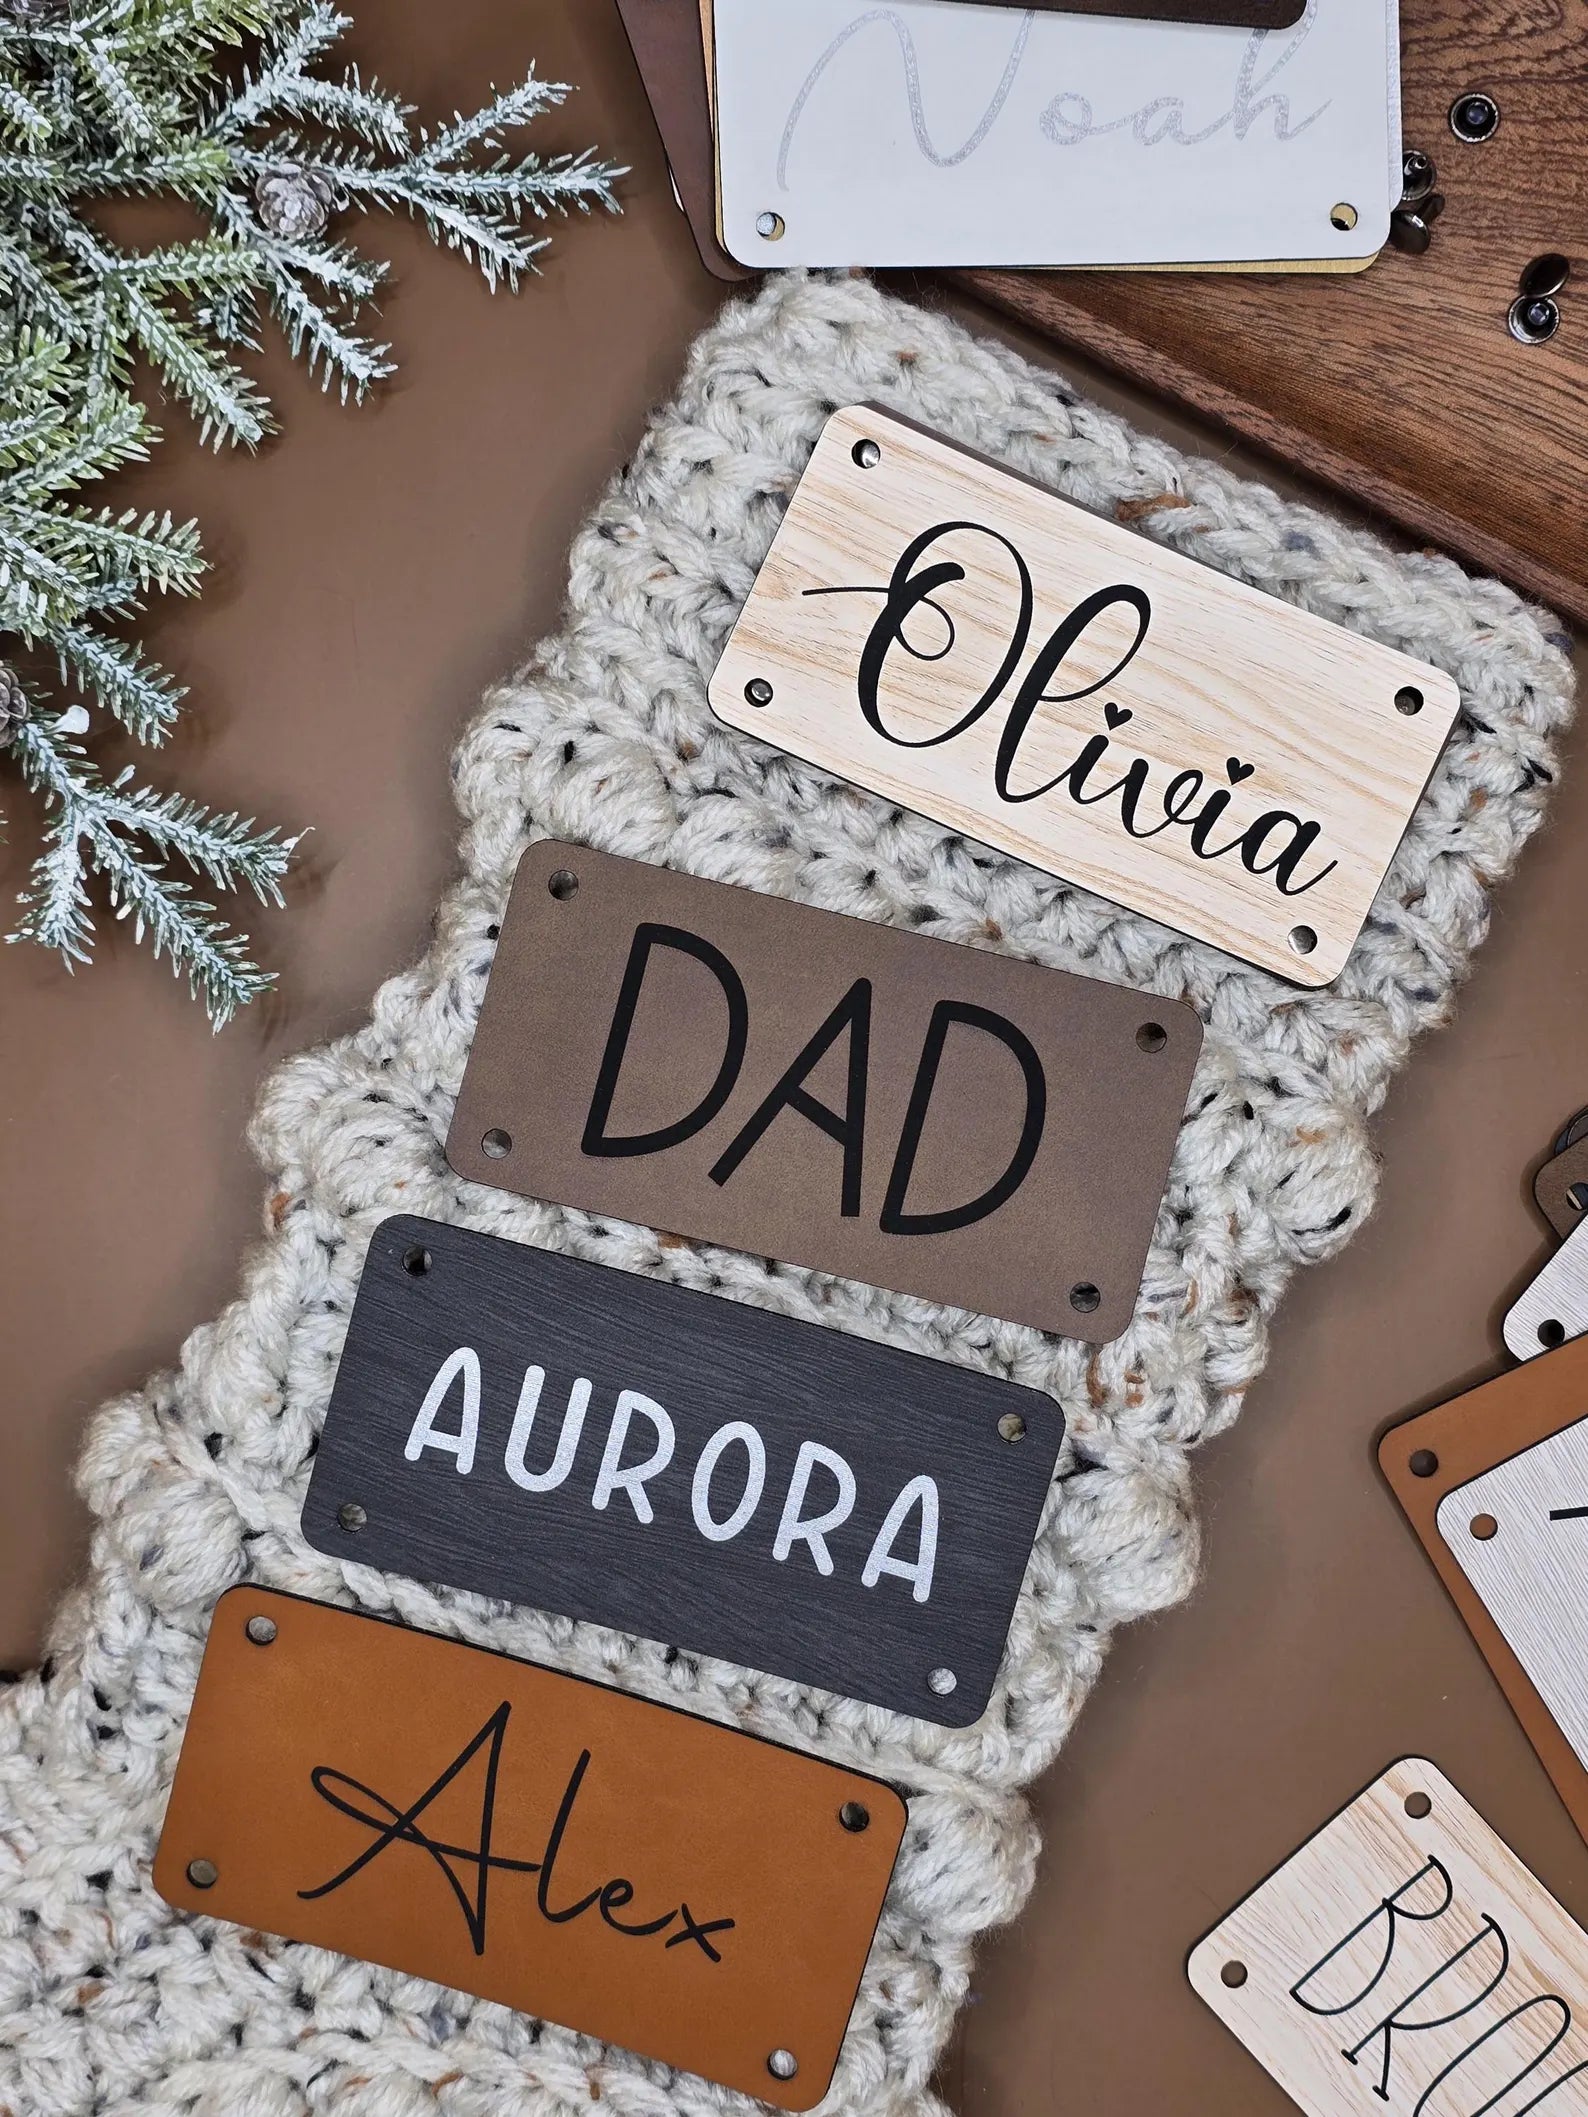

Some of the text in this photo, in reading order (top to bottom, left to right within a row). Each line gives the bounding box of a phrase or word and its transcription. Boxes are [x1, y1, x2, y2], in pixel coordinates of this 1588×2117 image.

[777, 0, 1335, 191] Noah
[803, 521, 1338, 896] Olivia
[581, 922, 1048, 1236] DAD
[405, 1345, 941, 1603] AURORA
[297, 1700, 736, 1962] Alex
[1289, 1855, 1588, 2117] BRO
